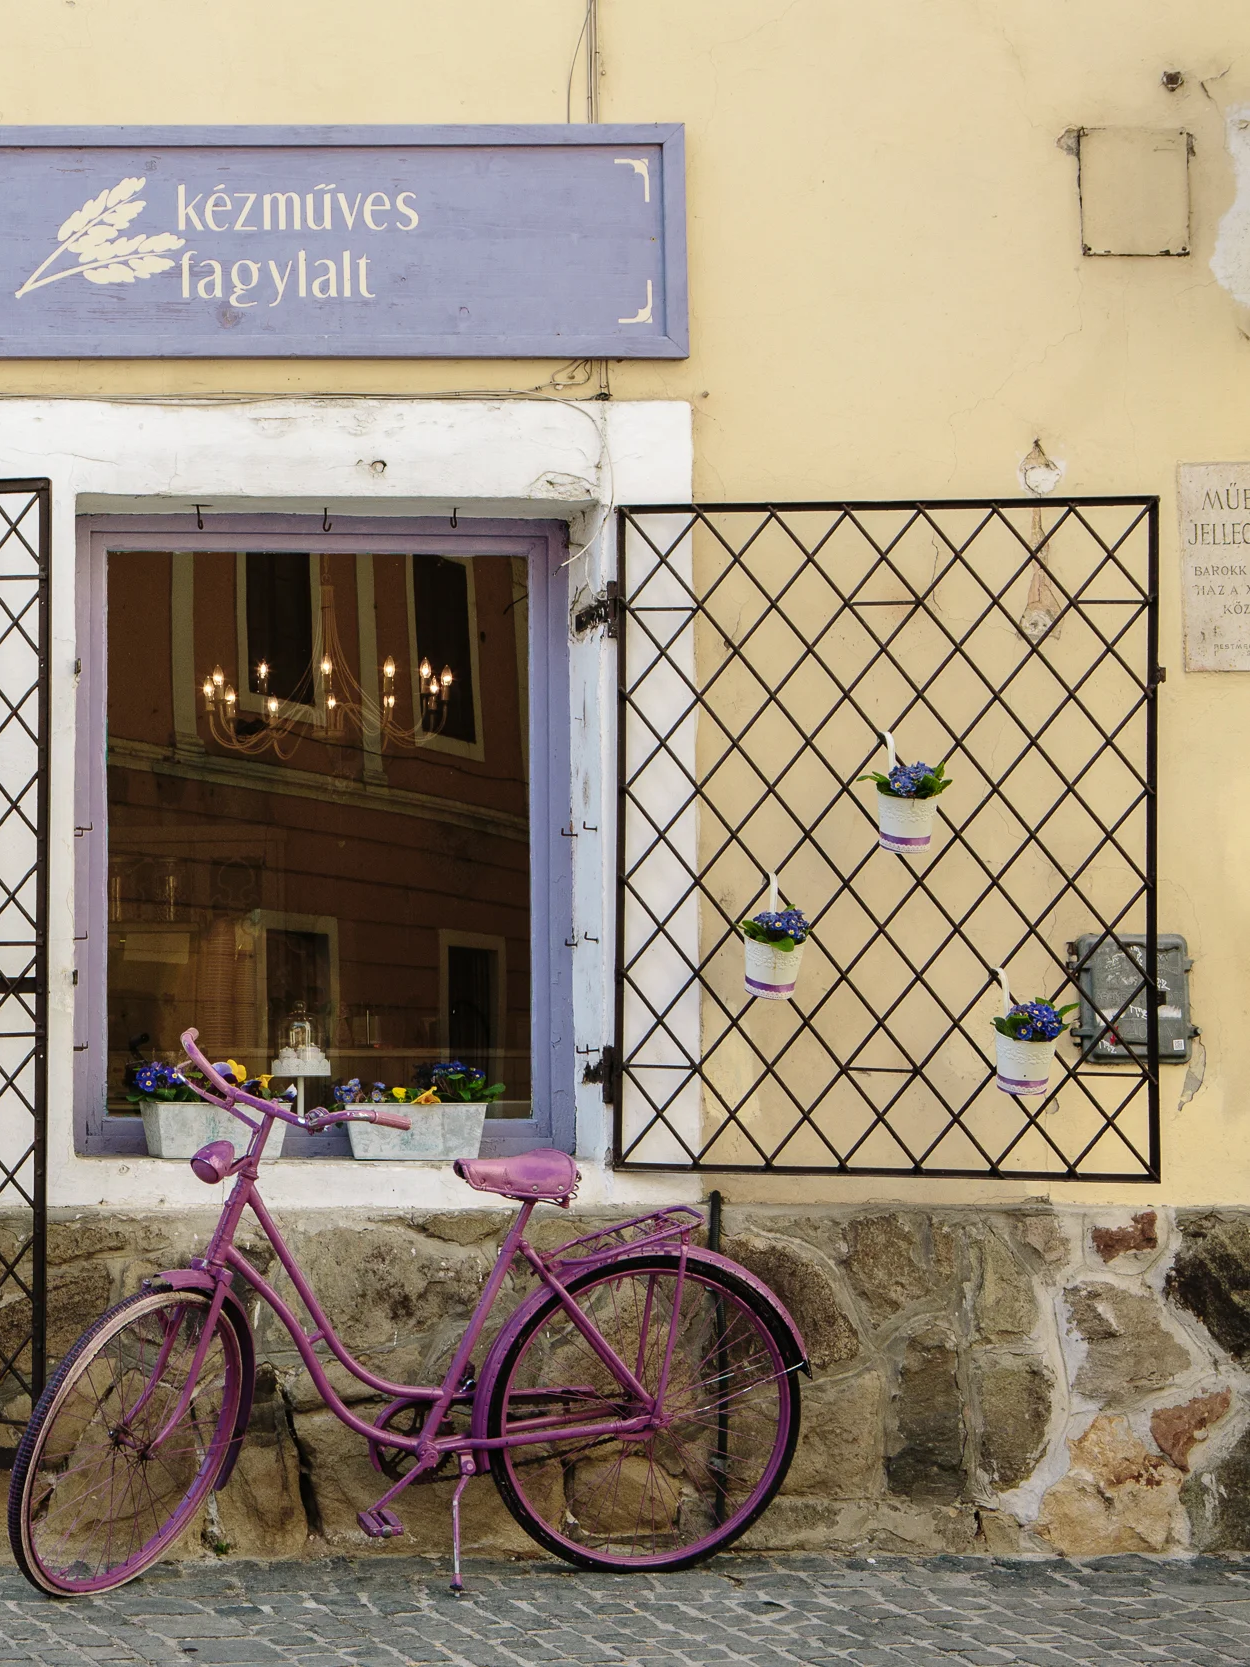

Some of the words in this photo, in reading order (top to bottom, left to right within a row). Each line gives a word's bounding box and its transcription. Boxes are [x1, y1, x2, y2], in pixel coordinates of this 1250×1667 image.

[177, 183, 419, 231] kézműves
[179, 250, 376, 308] fagylalt
[1194, 565, 1247, 576] BAROKK
